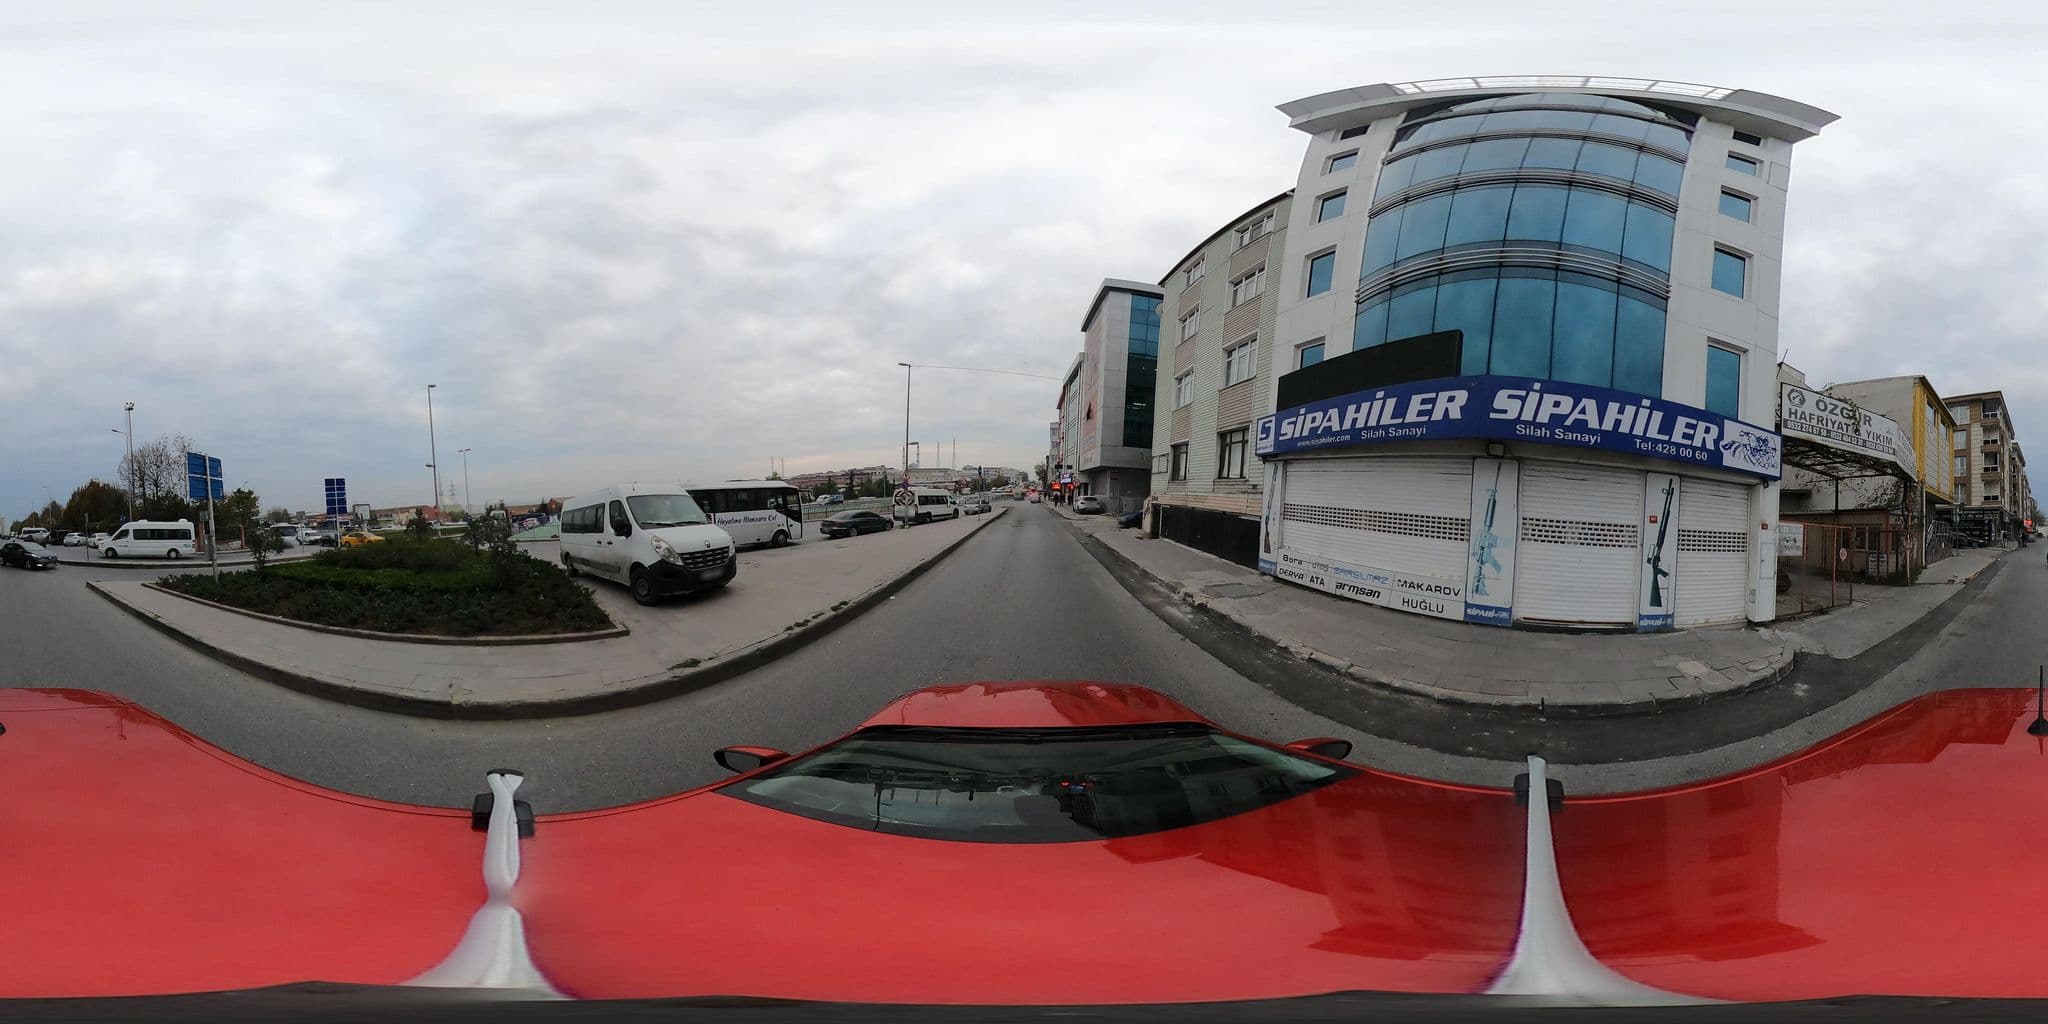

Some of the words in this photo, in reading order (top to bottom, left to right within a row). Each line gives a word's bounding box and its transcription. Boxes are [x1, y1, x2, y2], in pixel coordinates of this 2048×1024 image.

[1361, 429, 1385, 439] Silah
[1388, 425, 1426, 437] Sanayi
[1516, 424, 1550, 438] Silah
[1554, 428, 1601, 445] Sanayi
[1788, 408, 1850, 433] HAFRİYAT
[1866, 429, 1893, 446] YIKIM
[1634, 439, 1677, 455] Tel:428
[1679, 447, 1693, 458] 00
[1695, 451, 1708, 461] 60
[1283, 554, 1303, 566] Bora
[1279, 567, 1304, 580] DERYA
[1309, 575, 1325, 587] ATA
[1335, 581, 1381, 599] armsan
[1397, 579, 1461, 597] MAKAROV
[1402, 597, 1445, 614] HUĞLU
